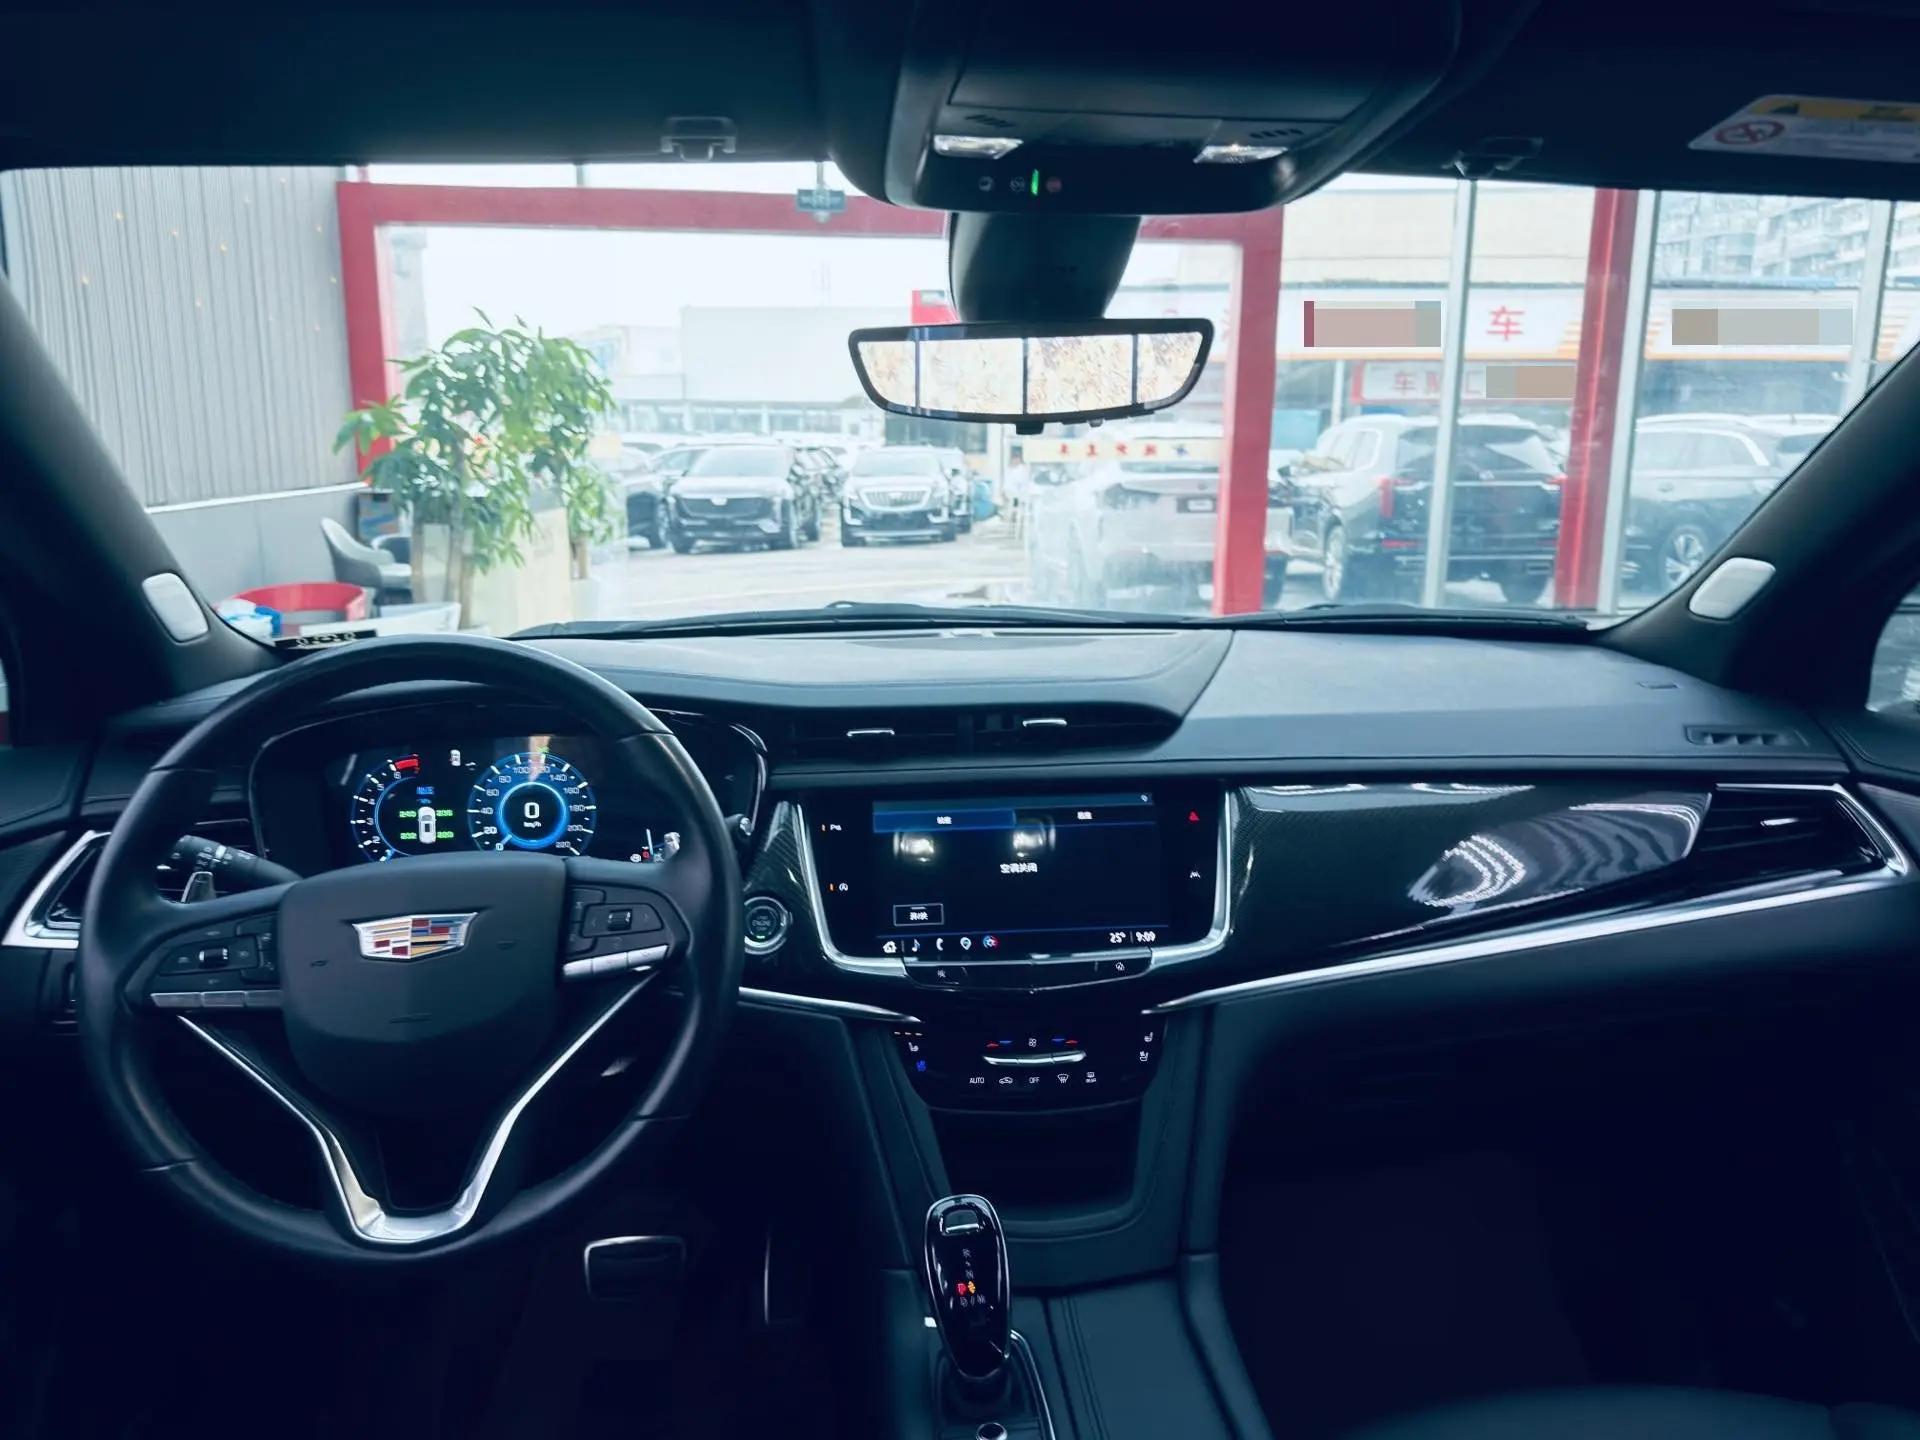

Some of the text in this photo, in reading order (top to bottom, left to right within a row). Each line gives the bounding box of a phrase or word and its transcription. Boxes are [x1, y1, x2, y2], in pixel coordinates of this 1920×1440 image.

[1486, 306, 1525, 341] 车
[480, 806, 494, 815] 40
[524, 802, 540, 819] 0
[366, 817, 374, 826] 3
[483, 826, 498, 834] 20
[371, 835, 381, 844] 2
[495, 841, 505, 851] 0
[969, 1076, 985, 1085] AUTO
[1029, 1076, 1040, 1085] OFF
